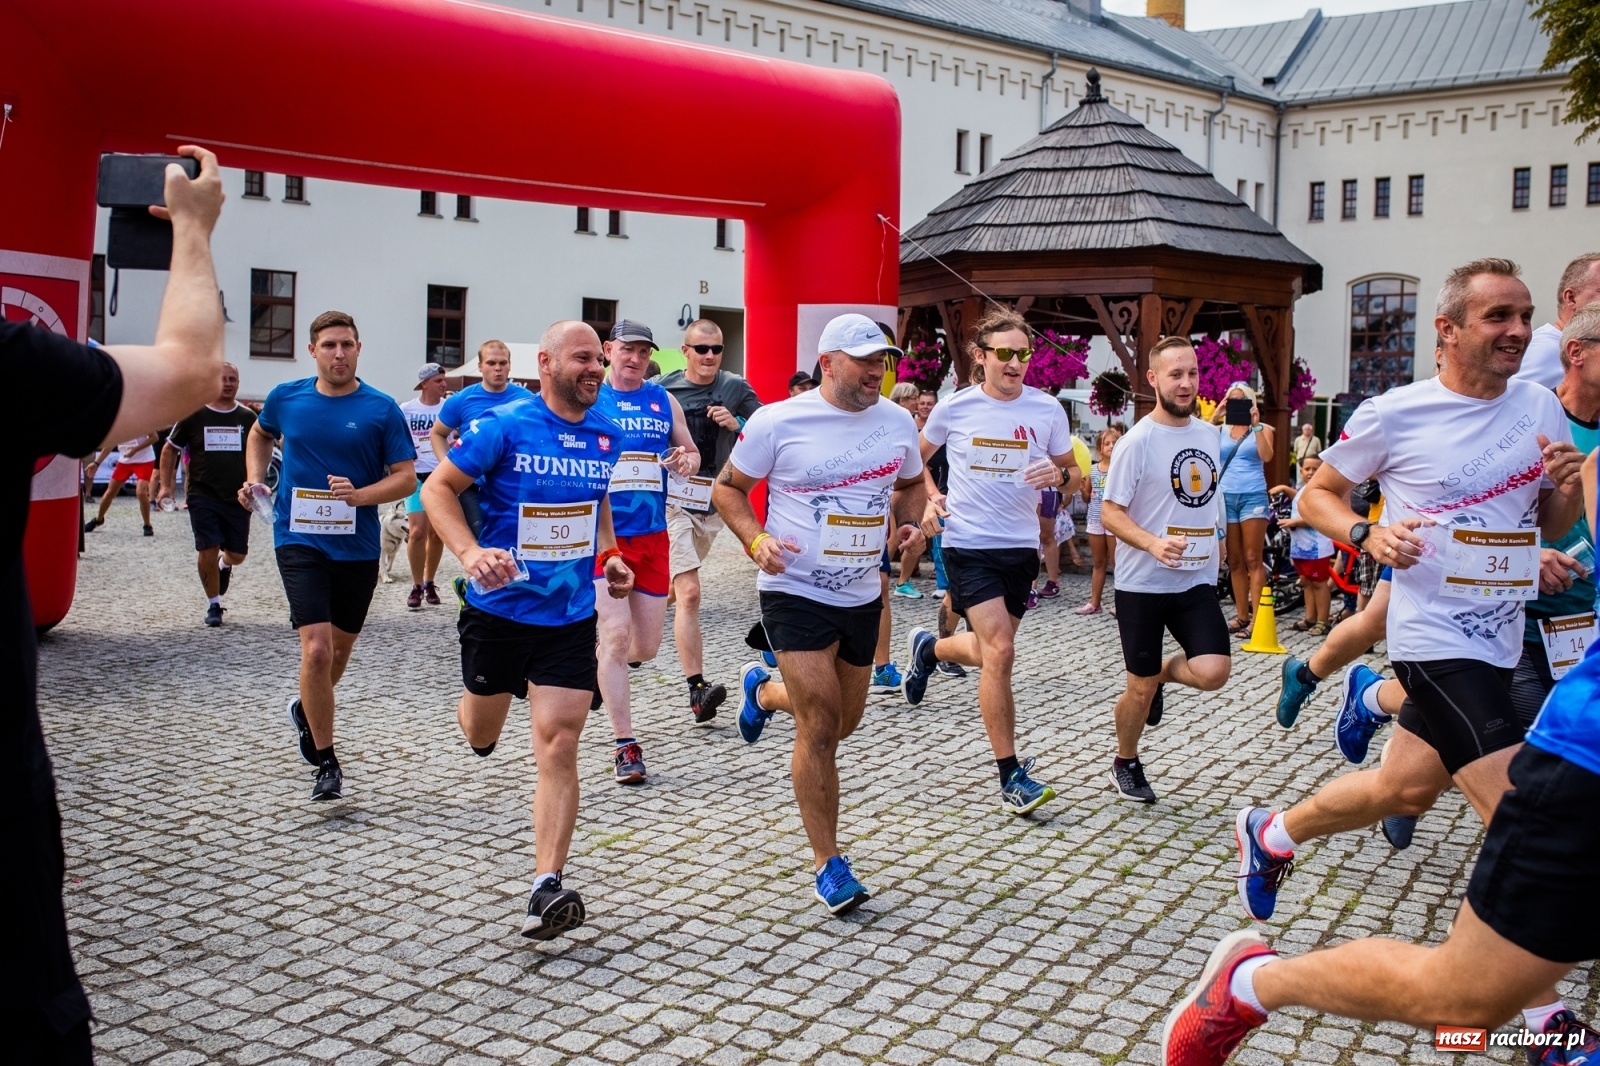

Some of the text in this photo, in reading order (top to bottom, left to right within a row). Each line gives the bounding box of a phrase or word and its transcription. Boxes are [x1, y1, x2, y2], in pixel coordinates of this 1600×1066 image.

[699, 280, 709, 294] B
[611, 417, 670, 434] NNERS
[805, 425, 890, 479] KS GRYF KIETRZ
[991, 453, 1007, 465] 47
[1438, 414, 1537, 490] KS GRYF KIETRZ
[1173, 450, 1194, 475] BIEGAM
[632, 465, 640, 476] 9
[587, 482, 607, 490] TEAM
[682, 486, 694, 497] 41
[315, 505, 332, 517] 43
[550, 524, 570, 540] 50
[851, 533, 867, 547] 11
[1471, 536, 1487, 544] Bieg
[1190, 542, 1197, 553] 7
[1485, 555, 1509, 574] 34
[1570, 636, 1585, 653] 14
